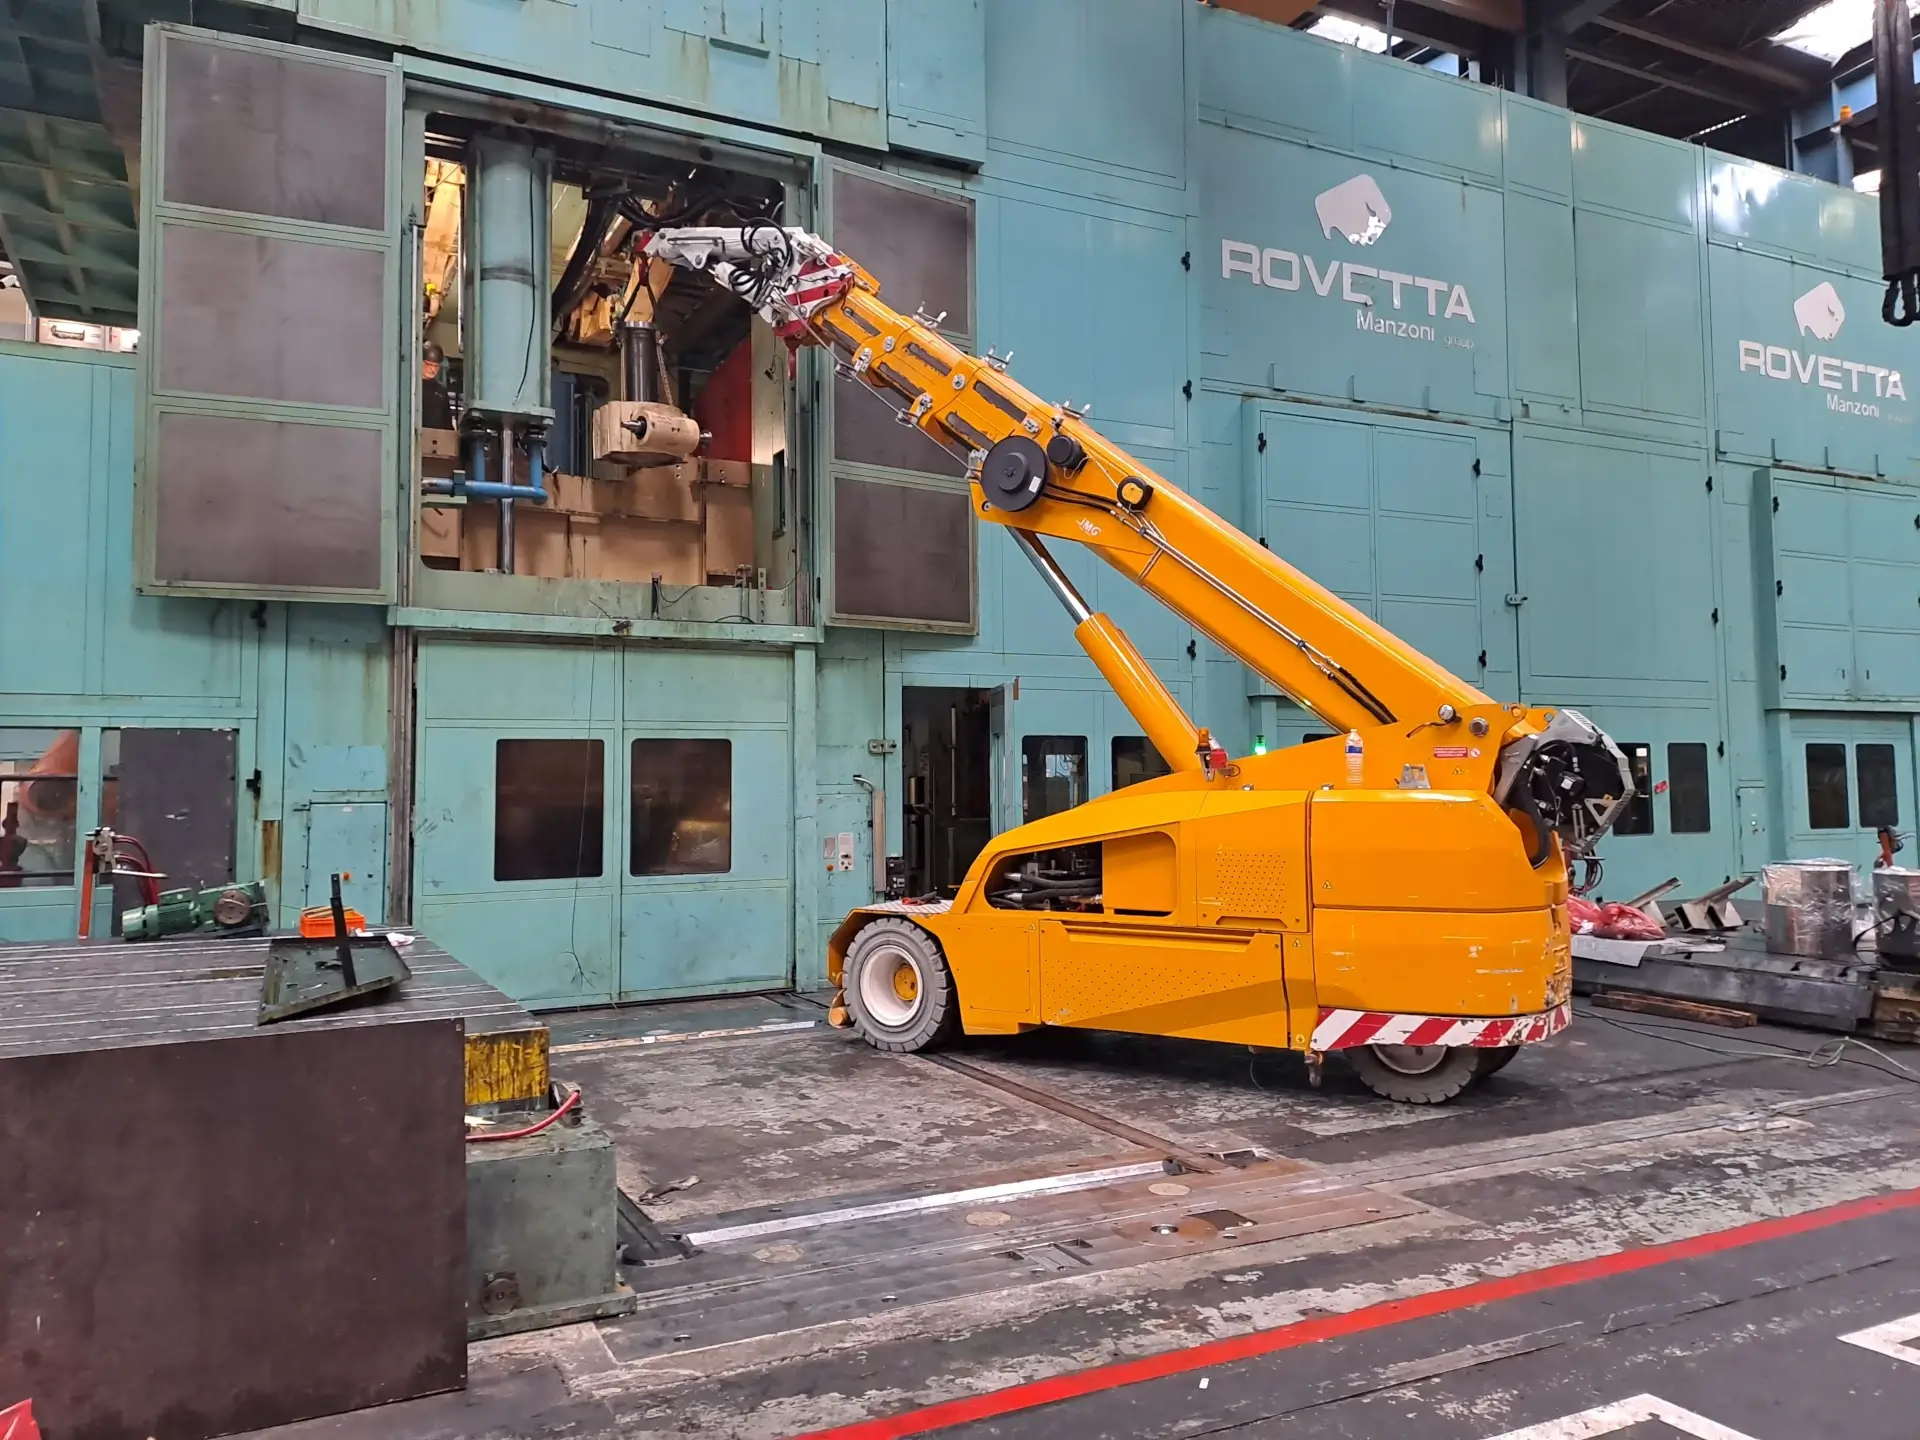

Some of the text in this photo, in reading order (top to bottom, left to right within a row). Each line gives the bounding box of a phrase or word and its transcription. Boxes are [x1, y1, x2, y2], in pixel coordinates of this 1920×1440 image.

[1221, 238, 1476, 324] ROVETTA
[1356, 308, 1435, 342] Manzoni
[1738, 339, 1907, 402] ROVETTA
[1826, 393, 1880, 418] Manzoni
